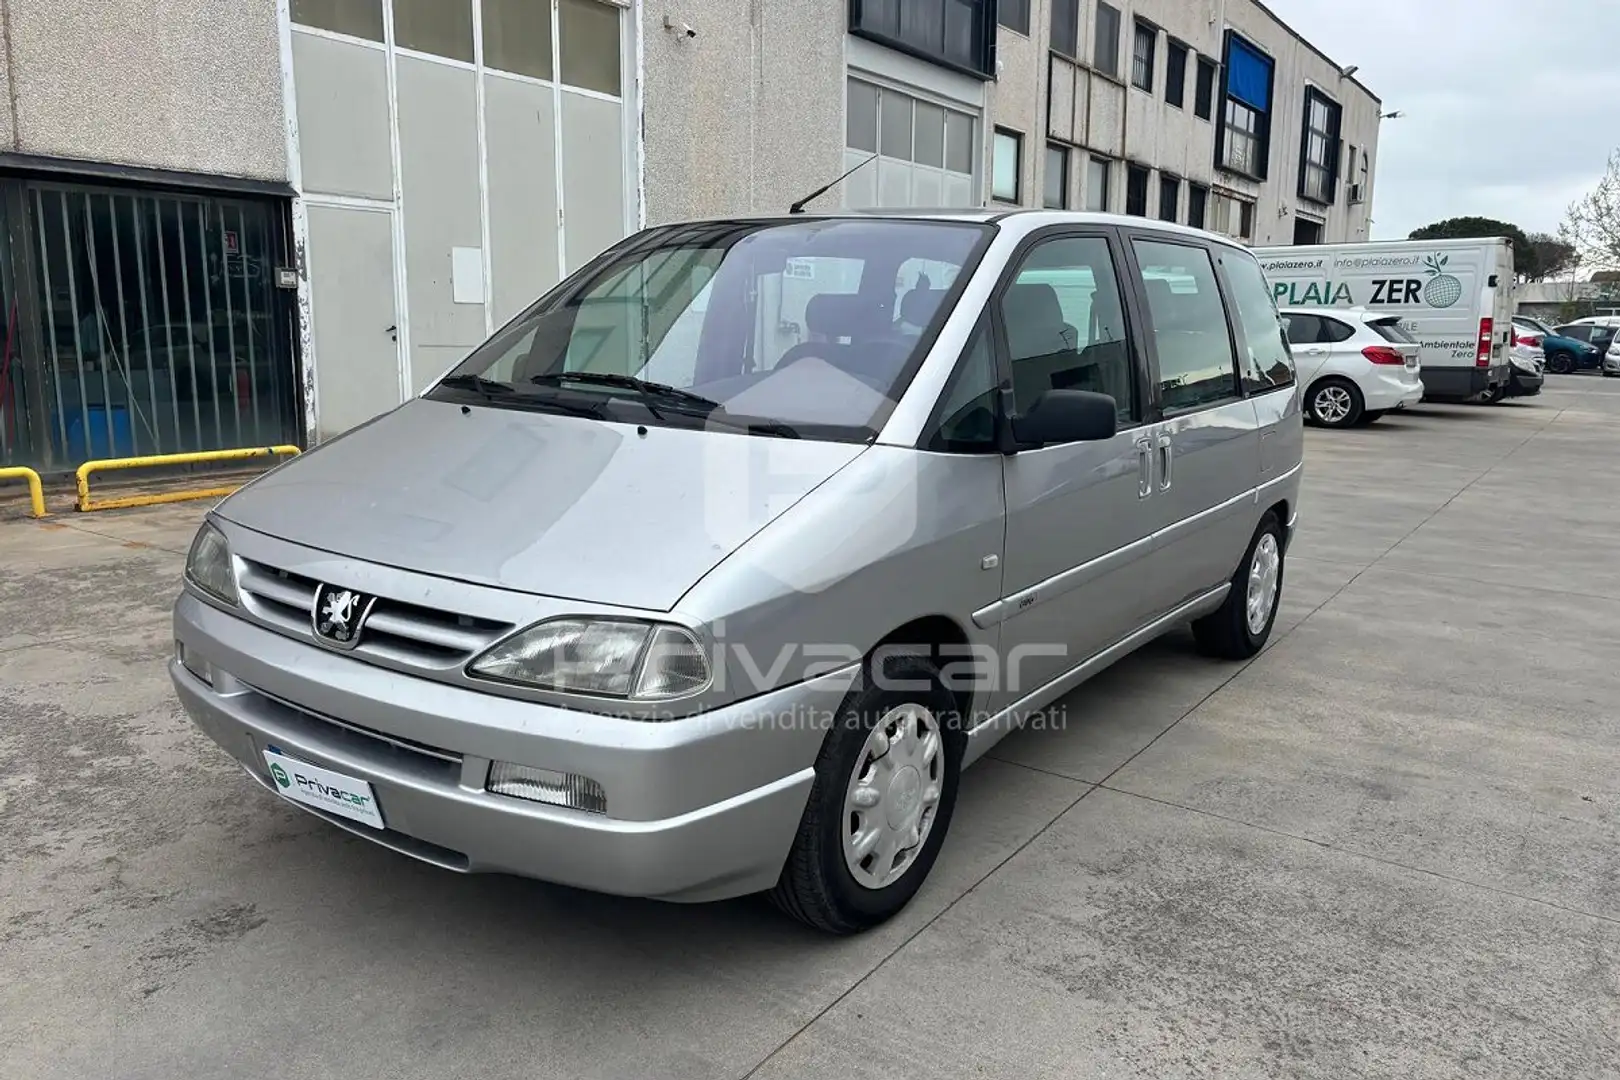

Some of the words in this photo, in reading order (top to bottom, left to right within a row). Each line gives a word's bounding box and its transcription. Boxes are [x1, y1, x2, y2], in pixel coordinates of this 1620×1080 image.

[1274, 281, 1353, 305] PLAIA
[1451, 350, 1475, 358] Zero
[294, 773, 370, 806] Privacar
